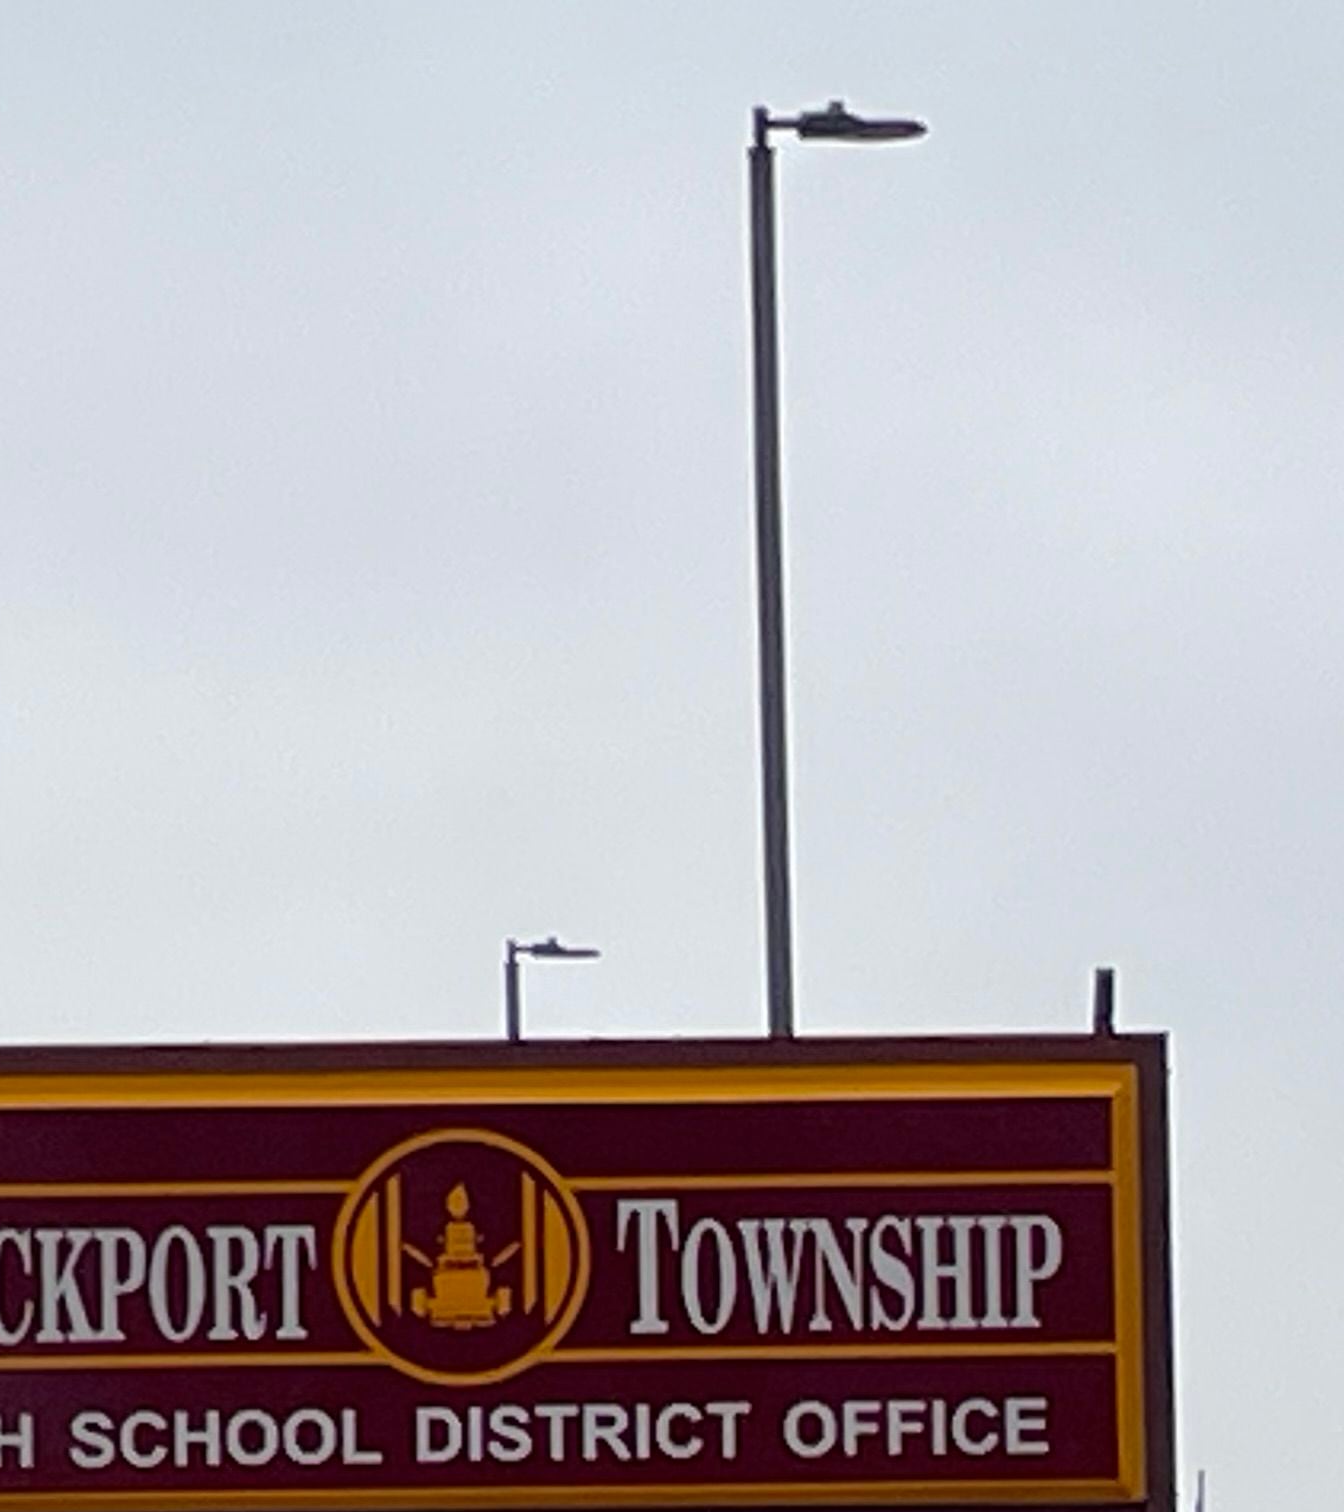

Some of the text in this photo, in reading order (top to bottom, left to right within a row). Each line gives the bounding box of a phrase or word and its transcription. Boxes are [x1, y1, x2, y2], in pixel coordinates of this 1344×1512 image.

[617, 1198, 1064, 1335] TOWNSHIP
[69, 1409, 383, 1468] SCHOOL
[416, 1402, 750, 1461] DISTRICT
[782, 1398, 1049, 1458] OFFICE
